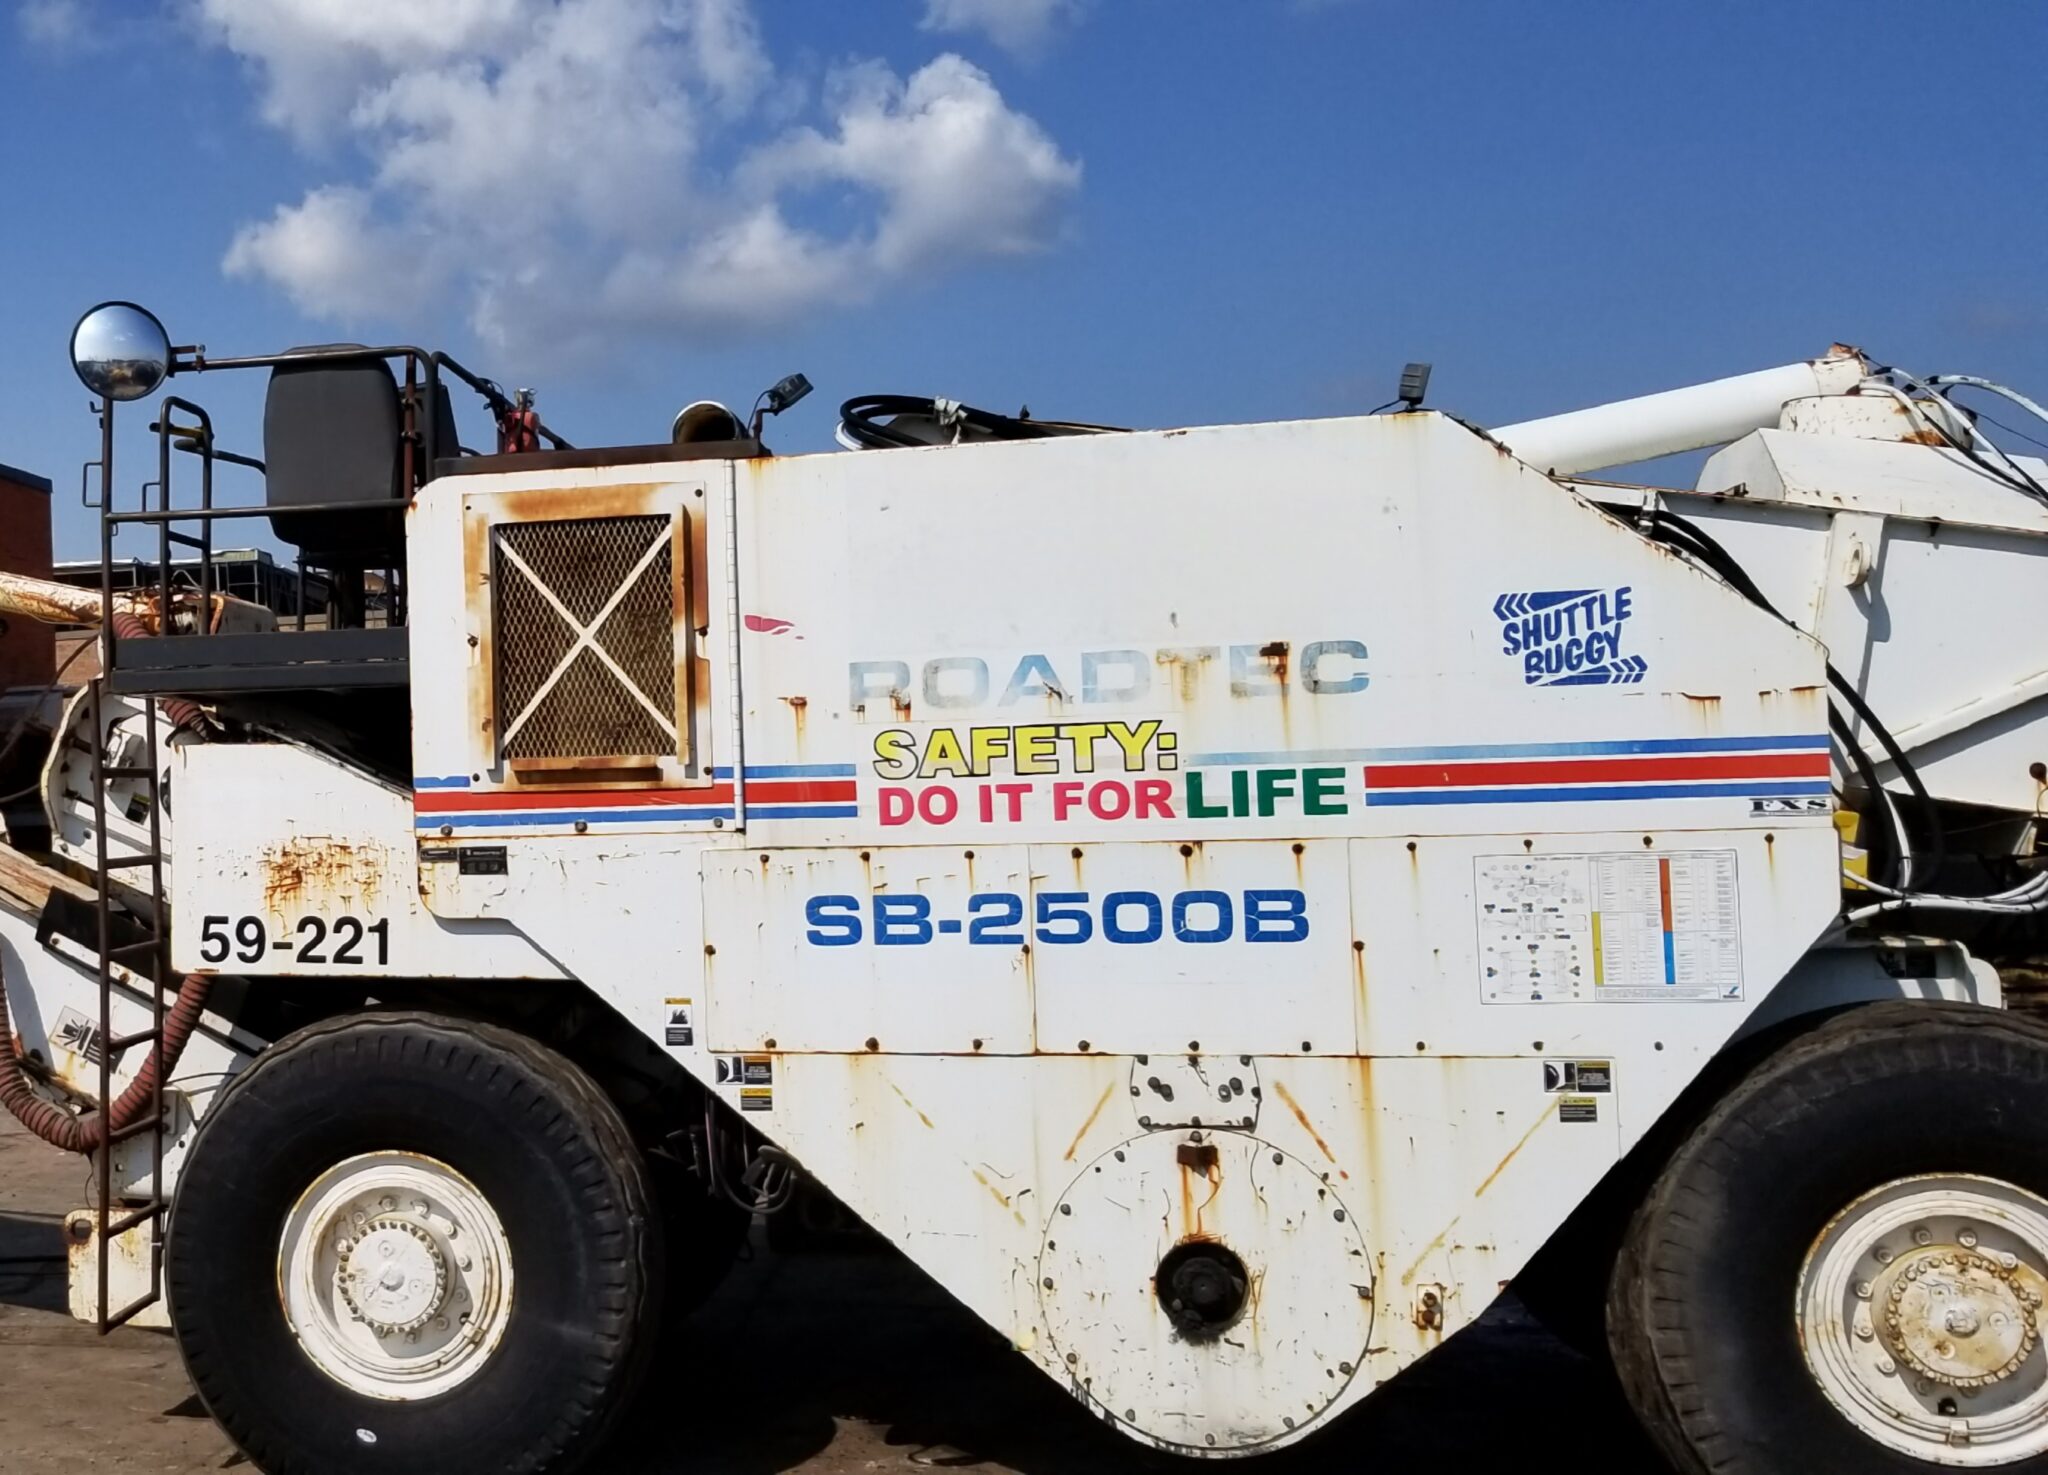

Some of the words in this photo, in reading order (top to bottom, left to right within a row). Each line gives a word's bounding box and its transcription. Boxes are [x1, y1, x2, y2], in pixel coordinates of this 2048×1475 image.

[1502, 586, 1632, 656] SHUTTLE
[849, 640, 1370, 711] ROADTEC
[1524, 622, 1622, 685] BUGGY
[873, 719, 1178, 779] SAFETY:
[878, 785, 959, 826] DO
[979, 783, 1033, 823] IT
[1053, 779, 1176, 822] FOR
[1185, 767, 1348, 819] LIFE
[200, 916, 389, 965] 59-221
[806, 889, 1310, 946] SB-2500B
